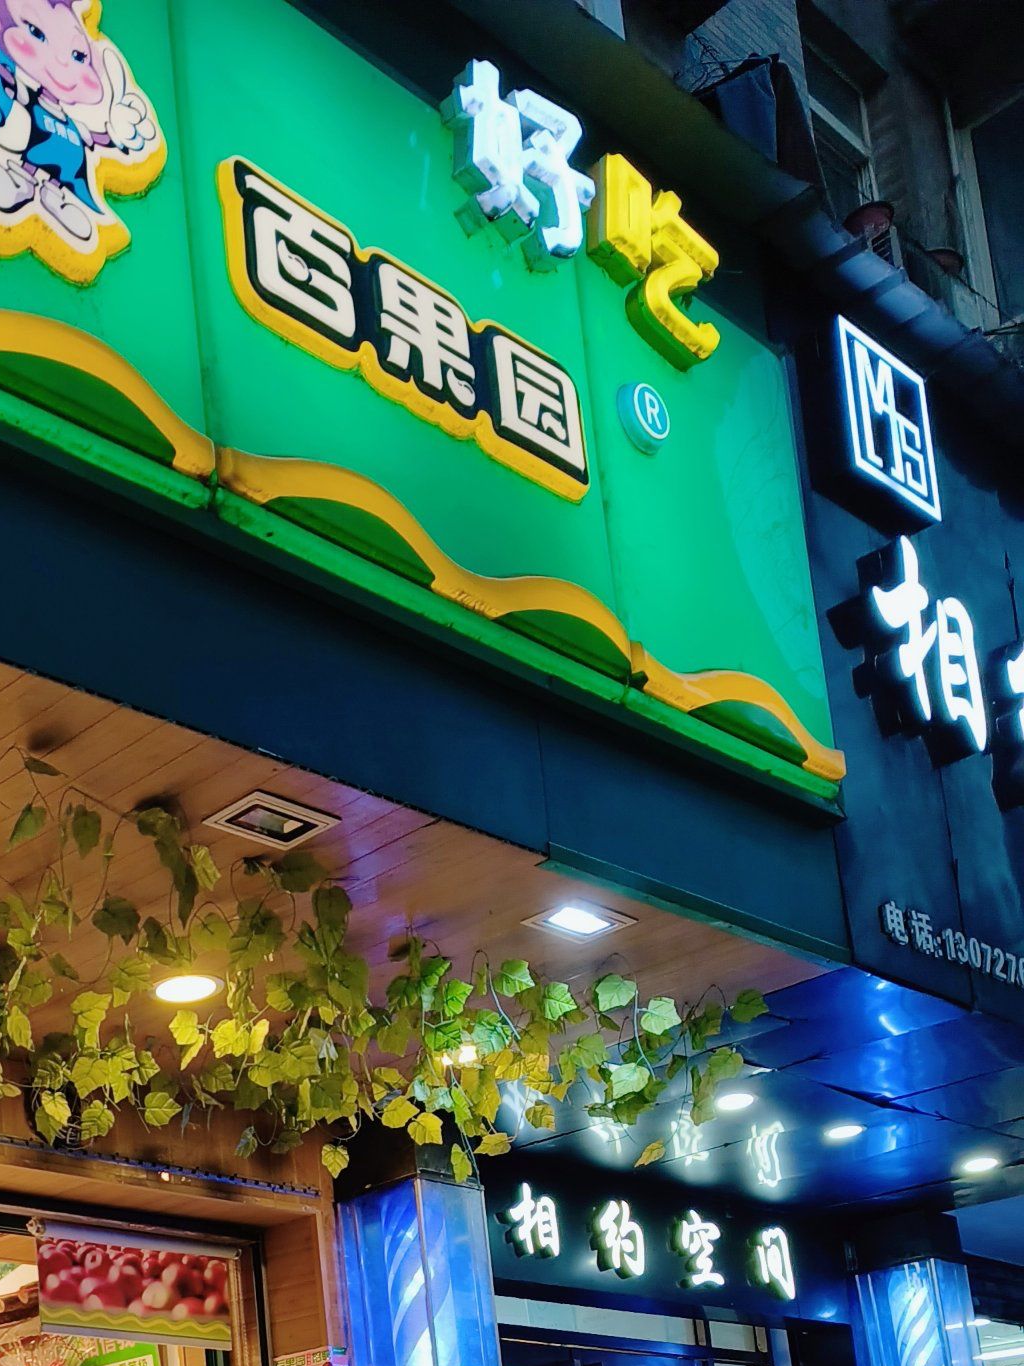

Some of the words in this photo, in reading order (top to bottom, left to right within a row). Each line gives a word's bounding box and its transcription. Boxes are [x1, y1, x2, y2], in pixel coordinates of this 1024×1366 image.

[245, 173, 586, 474] 百果园
[460, 58, 721, 360] 好吃
[510, 1182, 796, 1300] 相约空间
